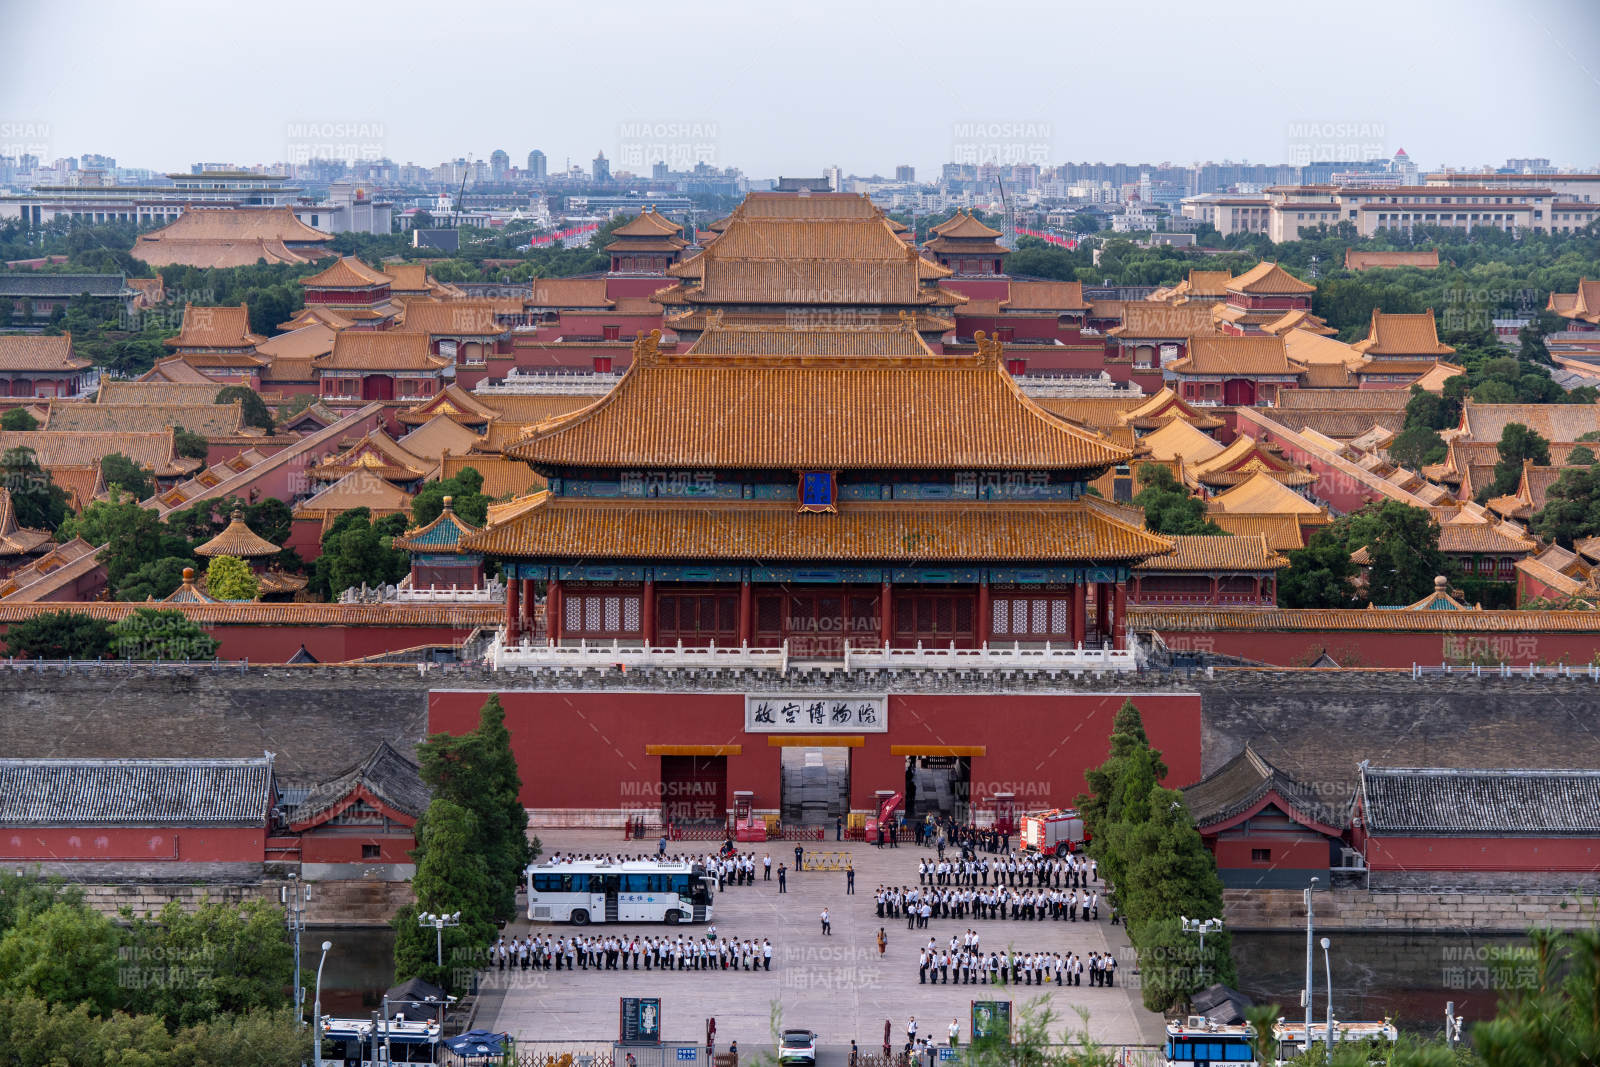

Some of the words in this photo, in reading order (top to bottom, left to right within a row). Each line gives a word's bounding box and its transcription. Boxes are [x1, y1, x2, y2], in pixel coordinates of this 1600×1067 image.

[755, 702, 876, 724] 故宫博物院
